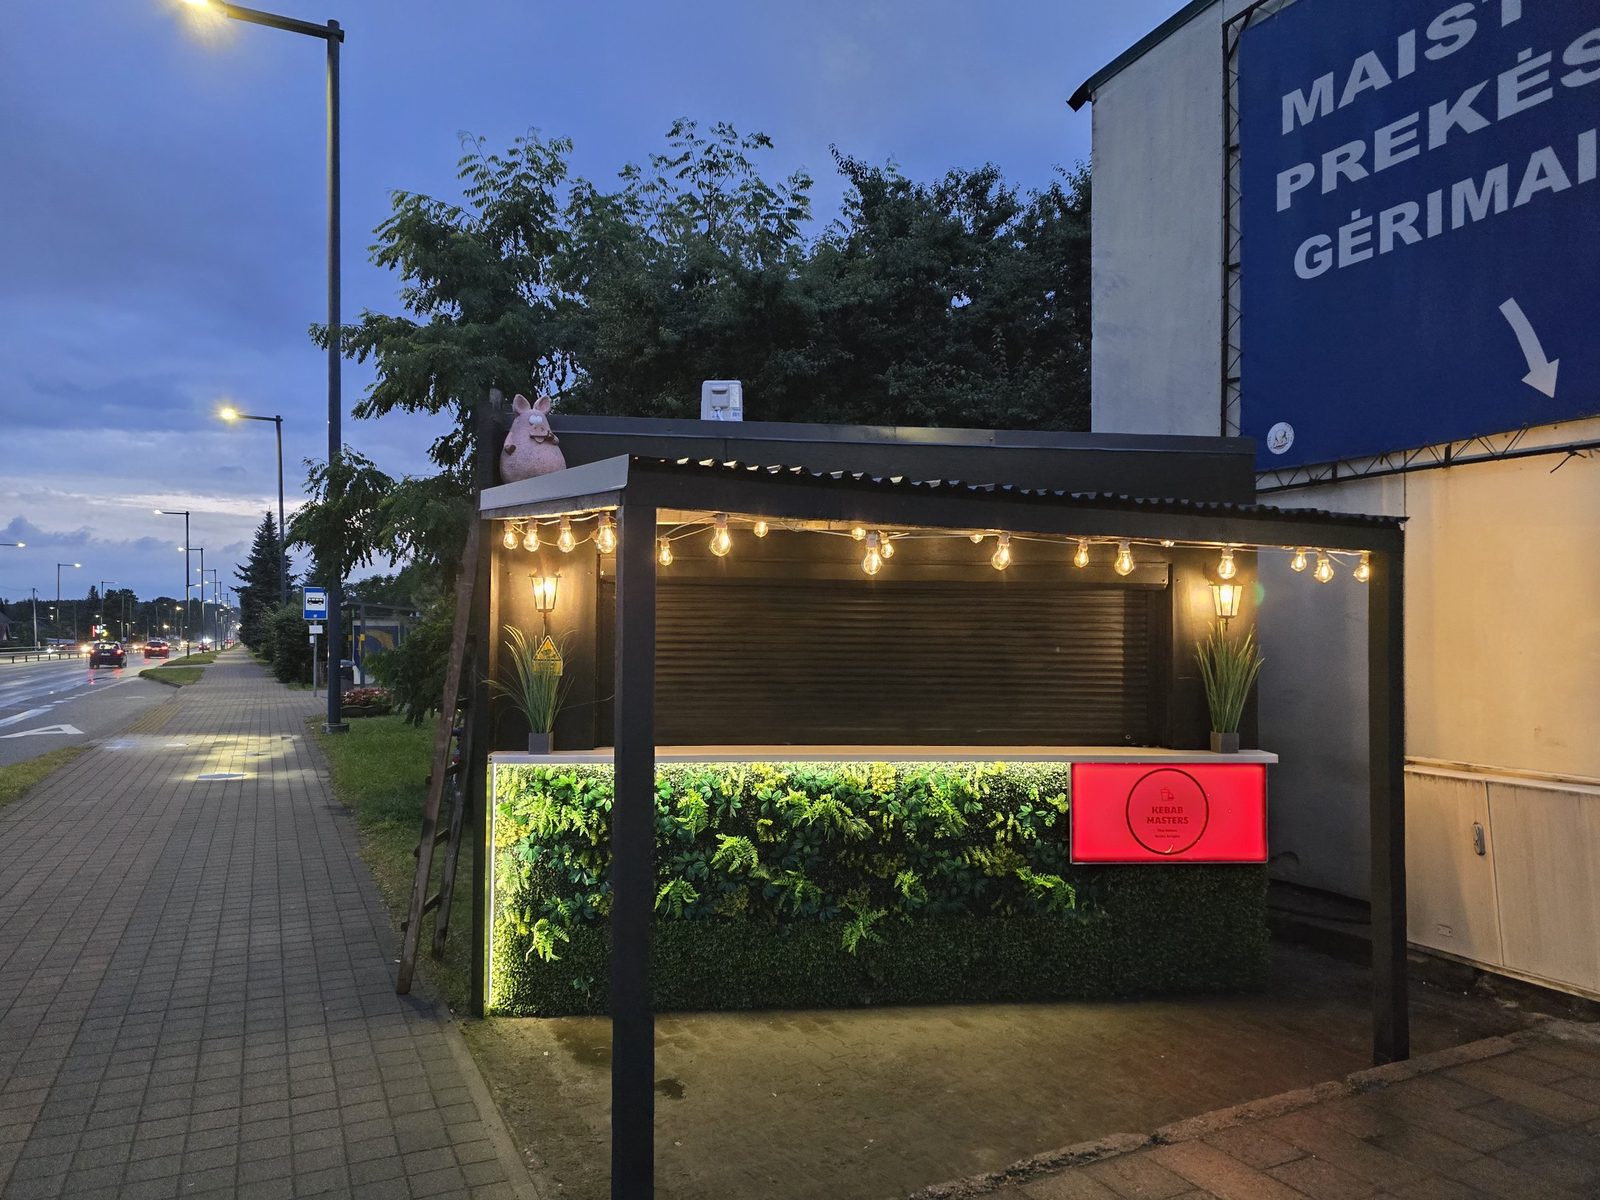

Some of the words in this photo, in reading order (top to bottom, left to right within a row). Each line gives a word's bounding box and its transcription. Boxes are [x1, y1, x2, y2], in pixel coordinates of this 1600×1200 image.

[1276, 29, 1600, 212] PREKĖS
[1293, 128, 1597, 280] GĖRIMAI
[1146, 816, 1190, 825] MASTERS
[1151, 806, 1184, 814] KEBAB
